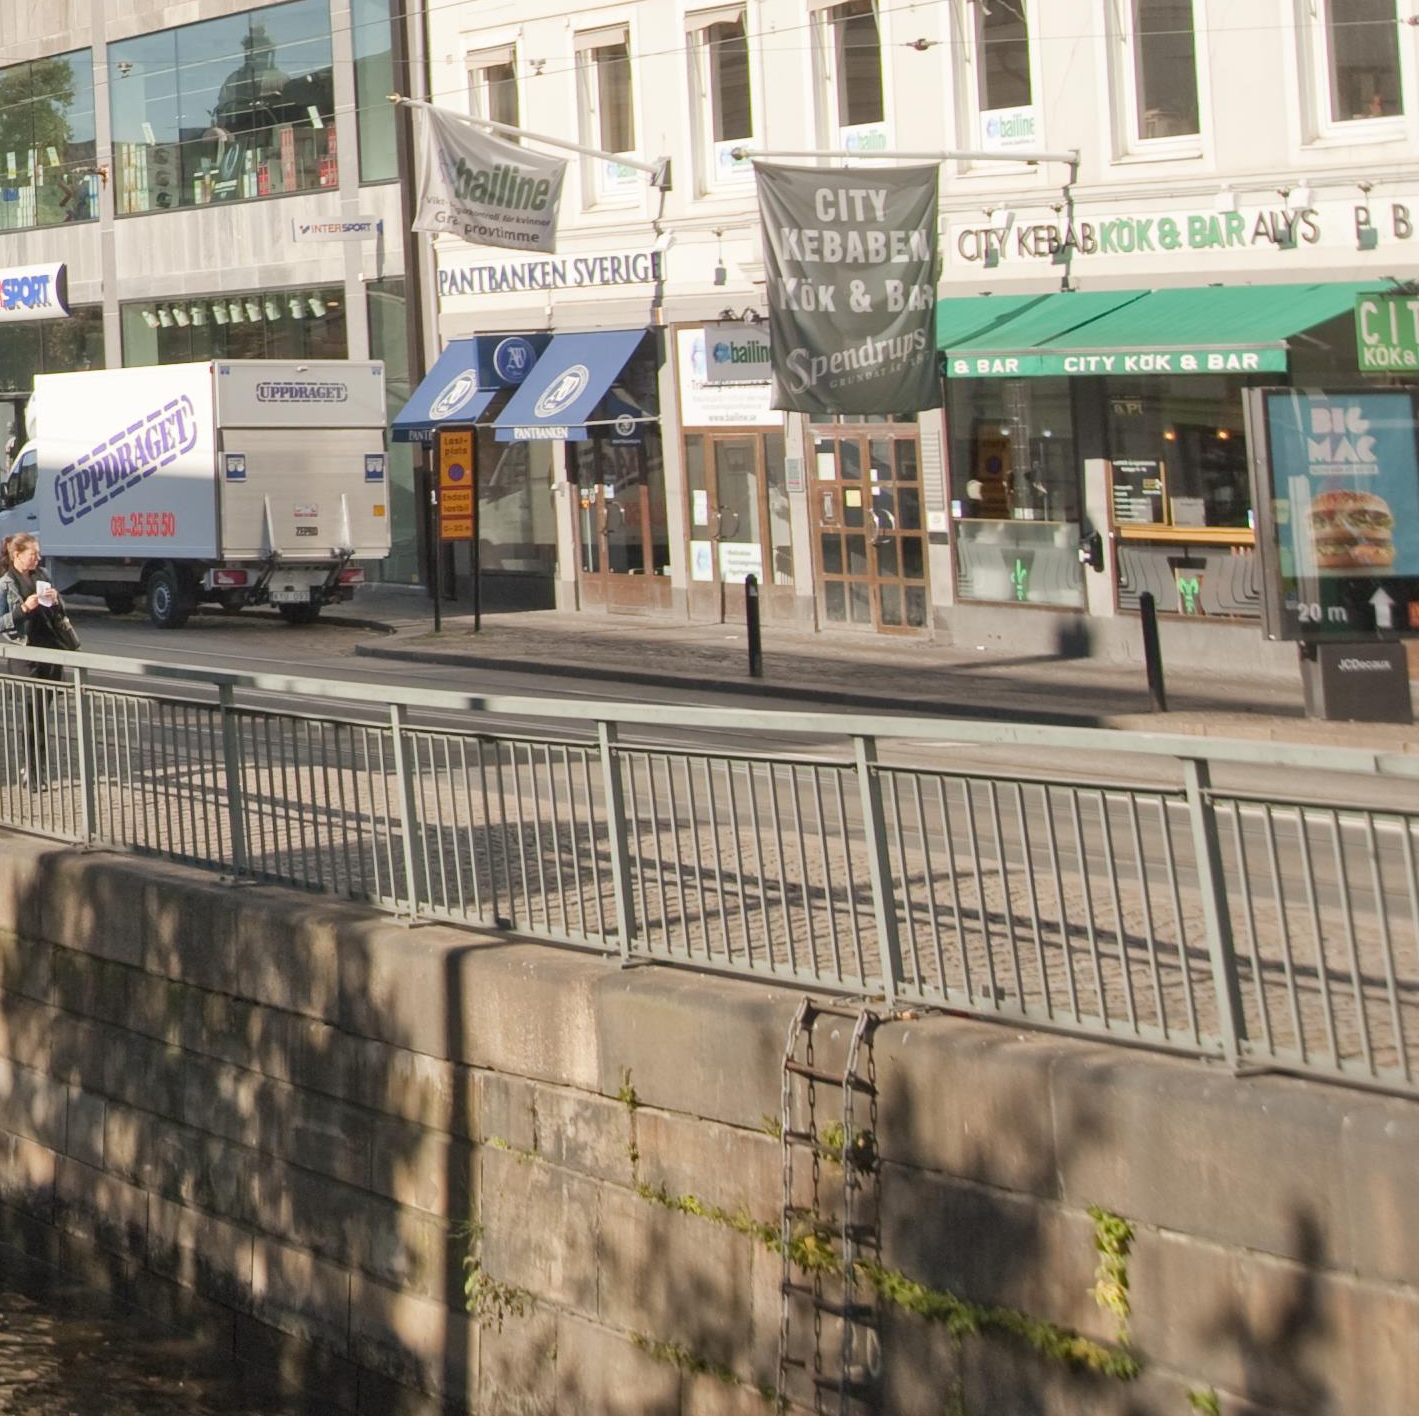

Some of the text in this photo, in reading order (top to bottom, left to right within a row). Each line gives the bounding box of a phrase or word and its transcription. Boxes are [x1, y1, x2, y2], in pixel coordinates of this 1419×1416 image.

[455, 156, 550, 211] bailine
[815, 188, 887, 222] CITY
[311, 222, 372, 234] INTERSPORT
[464, 224, 540, 243] provtimme
[958, 228, 1011, 262] CITY
[1018, 221, 1098, 258] KEBAB
[1099, 217, 1156, 253] KÖK
[1157, 217, 1183, 252] &
[1187, 211, 1246, 249] BAR
[1251, 209, 1321, 245] ALYS
[780, 228, 931, 264] KEBABEN
[438, 251, 662, 296] PANTBANKEN SVERIGE
[777, 277, 934, 313] KÖK & BAR
[730, 341, 770, 363] bailin
[786, 328, 927, 394] Spendrups
[1064, 353, 1260, 372] CITY KÖK & BAR
[954, 360, 970, 374] &
[976, 358, 1019, 374] BAR
[260, 386, 344, 399] UPPDRAGET
[514, 427, 569, 440] PANTBANKEN
[1311, 407, 1371, 434] BIG
[59, 406, 188, 513] UPPDRAGET
[1307, 435, 1378, 463] MAC
[1297, 603, 1349, 623] 20 m
